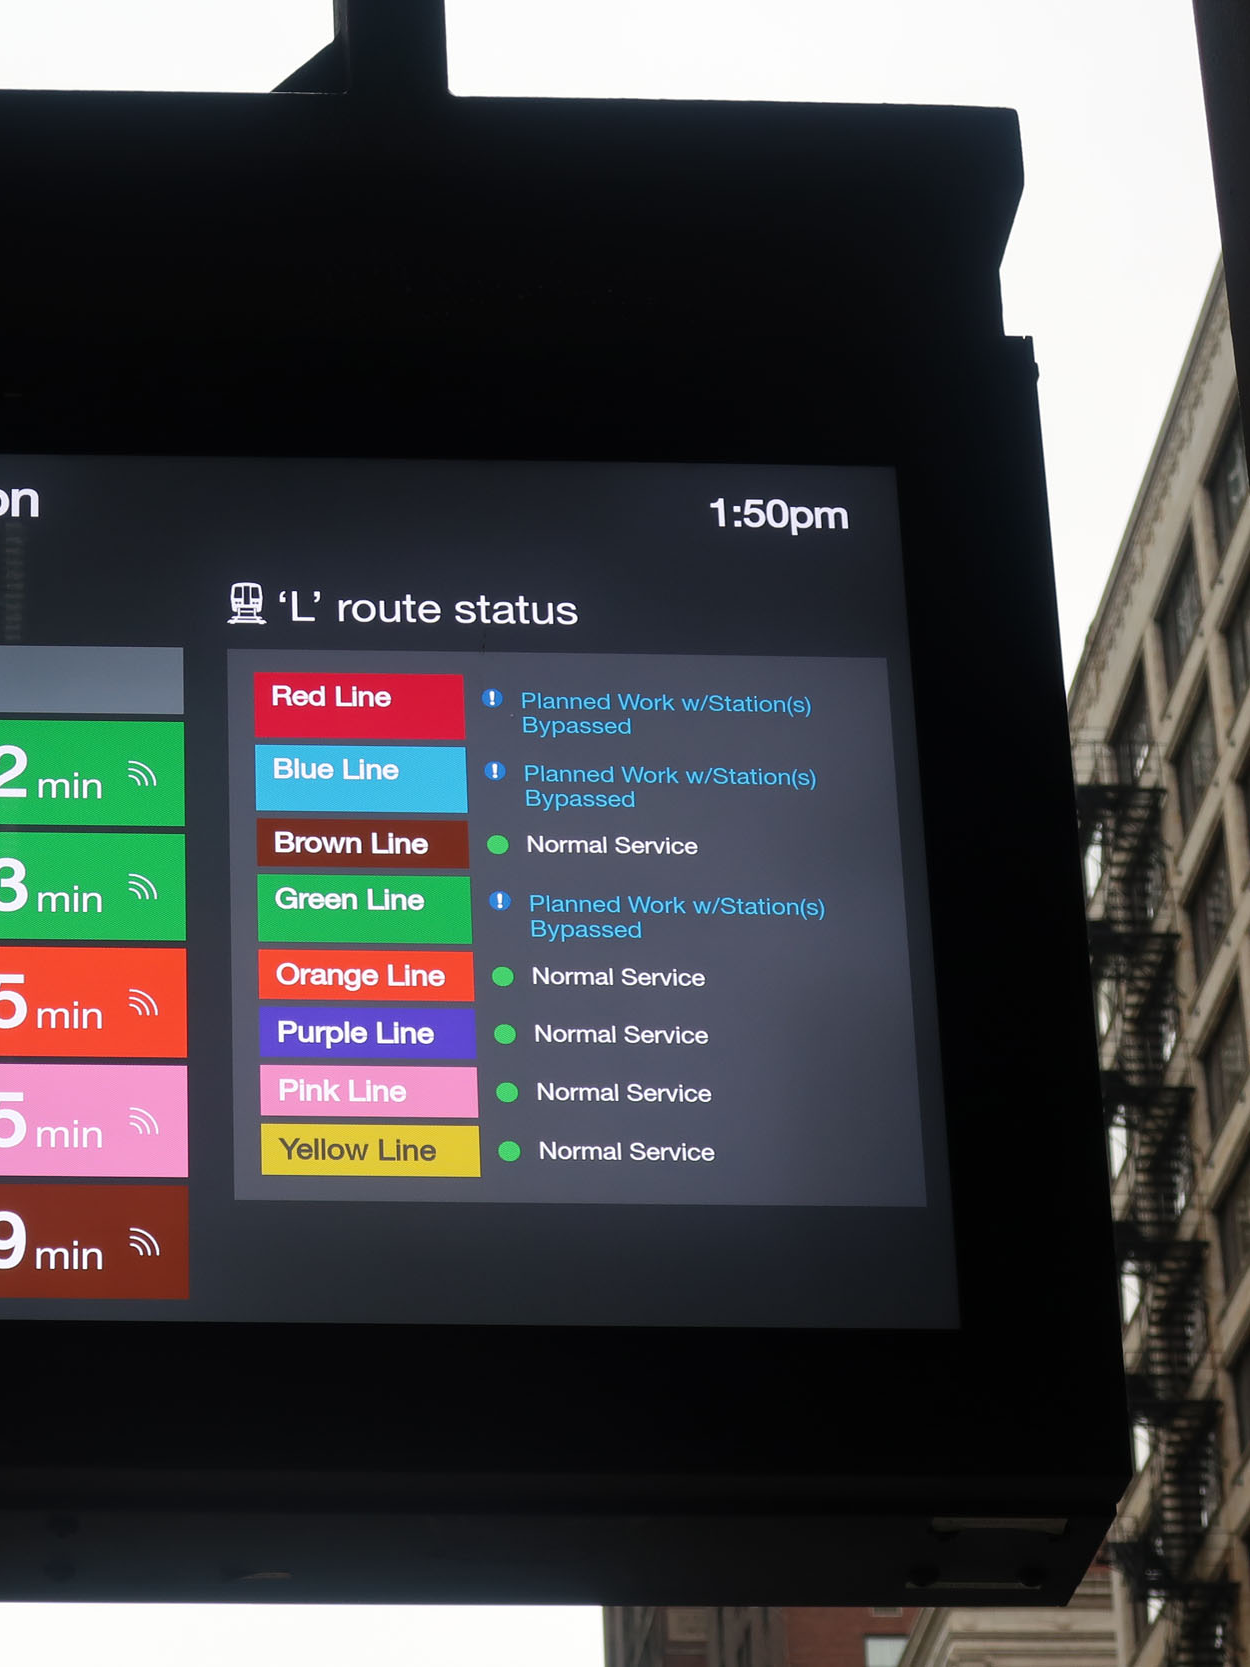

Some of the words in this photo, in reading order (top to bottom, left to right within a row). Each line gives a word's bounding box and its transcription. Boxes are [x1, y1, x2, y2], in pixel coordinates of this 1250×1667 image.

[709, 497, 849, 536] 1:50pm
[338, 593, 442, 624] route
[454, 594, 579, 626] status
[272, 684, 326, 707] Red
[335, 685, 392, 708] Line
[521, 691, 611, 712] Planned
[617, 693, 675, 713] Work
[681, 694, 812, 718] w/Station(s)
[522, 716, 632, 738] Bypassed
[273, 757, 335, 780] Blue
[342, 758, 400, 781] Line
[524, 764, 615, 785] Planned
[621, 766, 679, 786] Work
[685, 767, 816, 791] w/Station(s)
[37, 771, 103, 799] min
[525, 789, 635, 812] Bypassed
[274, 830, 362, 854] Brown
[371, 832, 429, 855] Line
[527, 835, 608, 854] Normal
[614, 836, 698, 855] Service
[37, 885, 103, 913] min
[274, 886, 358, 910] Green
[366, 888, 425, 911] Line
[529, 894, 621, 915] Planned
[627, 895, 687, 914] Work
[692, 897, 825, 921] w/Station(s)
[531, 919, 642, 943] Bypassed
[275, 962, 380, 992] Orange
[387, 963, 446, 987] Line
[532, 966, 614, 986] Normal
[621, 967, 706, 987] Service
[37, 1000, 103, 1030] min
[277, 1020, 368, 1050] Purple
[376, 1021, 435, 1045] Line
[534, 1024, 617, 1044] Normal
[623, 1025, 709, 1045] Service
[279, 1078, 341, 1102] Pink
[348, 1079, 407, 1103] Line
[537, 1082, 619, 1102] Normal
[626, 1083, 712, 1103] Service
[36, 1119, 103, 1149] min
[278, 1137, 369, 1161] Yellow
[378, 1138, 437, 1162] Line
[539, 1140, 622, 1161] Normal
[629, 1142, 715, 1162] Service
[35, 1240, 103, 1270] min
